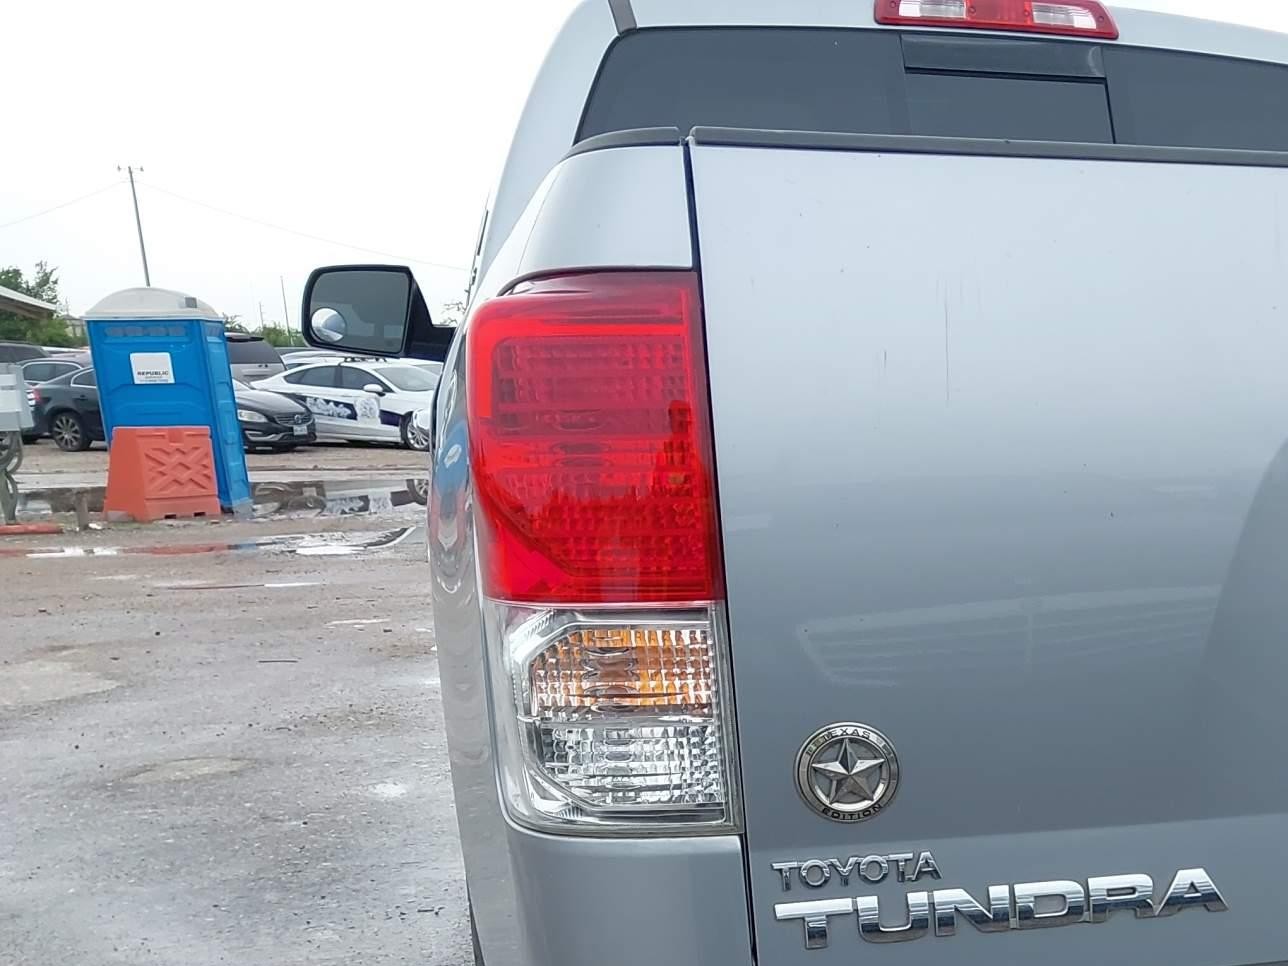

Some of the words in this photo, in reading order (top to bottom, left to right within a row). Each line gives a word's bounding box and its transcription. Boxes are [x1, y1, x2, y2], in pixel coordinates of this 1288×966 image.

[824, 727, 872, 742] TEXAS
[821, 803, 883, 821] EDITION
[771, 849, 943, 892] TOYOTA
[772, 866, 1229, 950] TUNDRA
